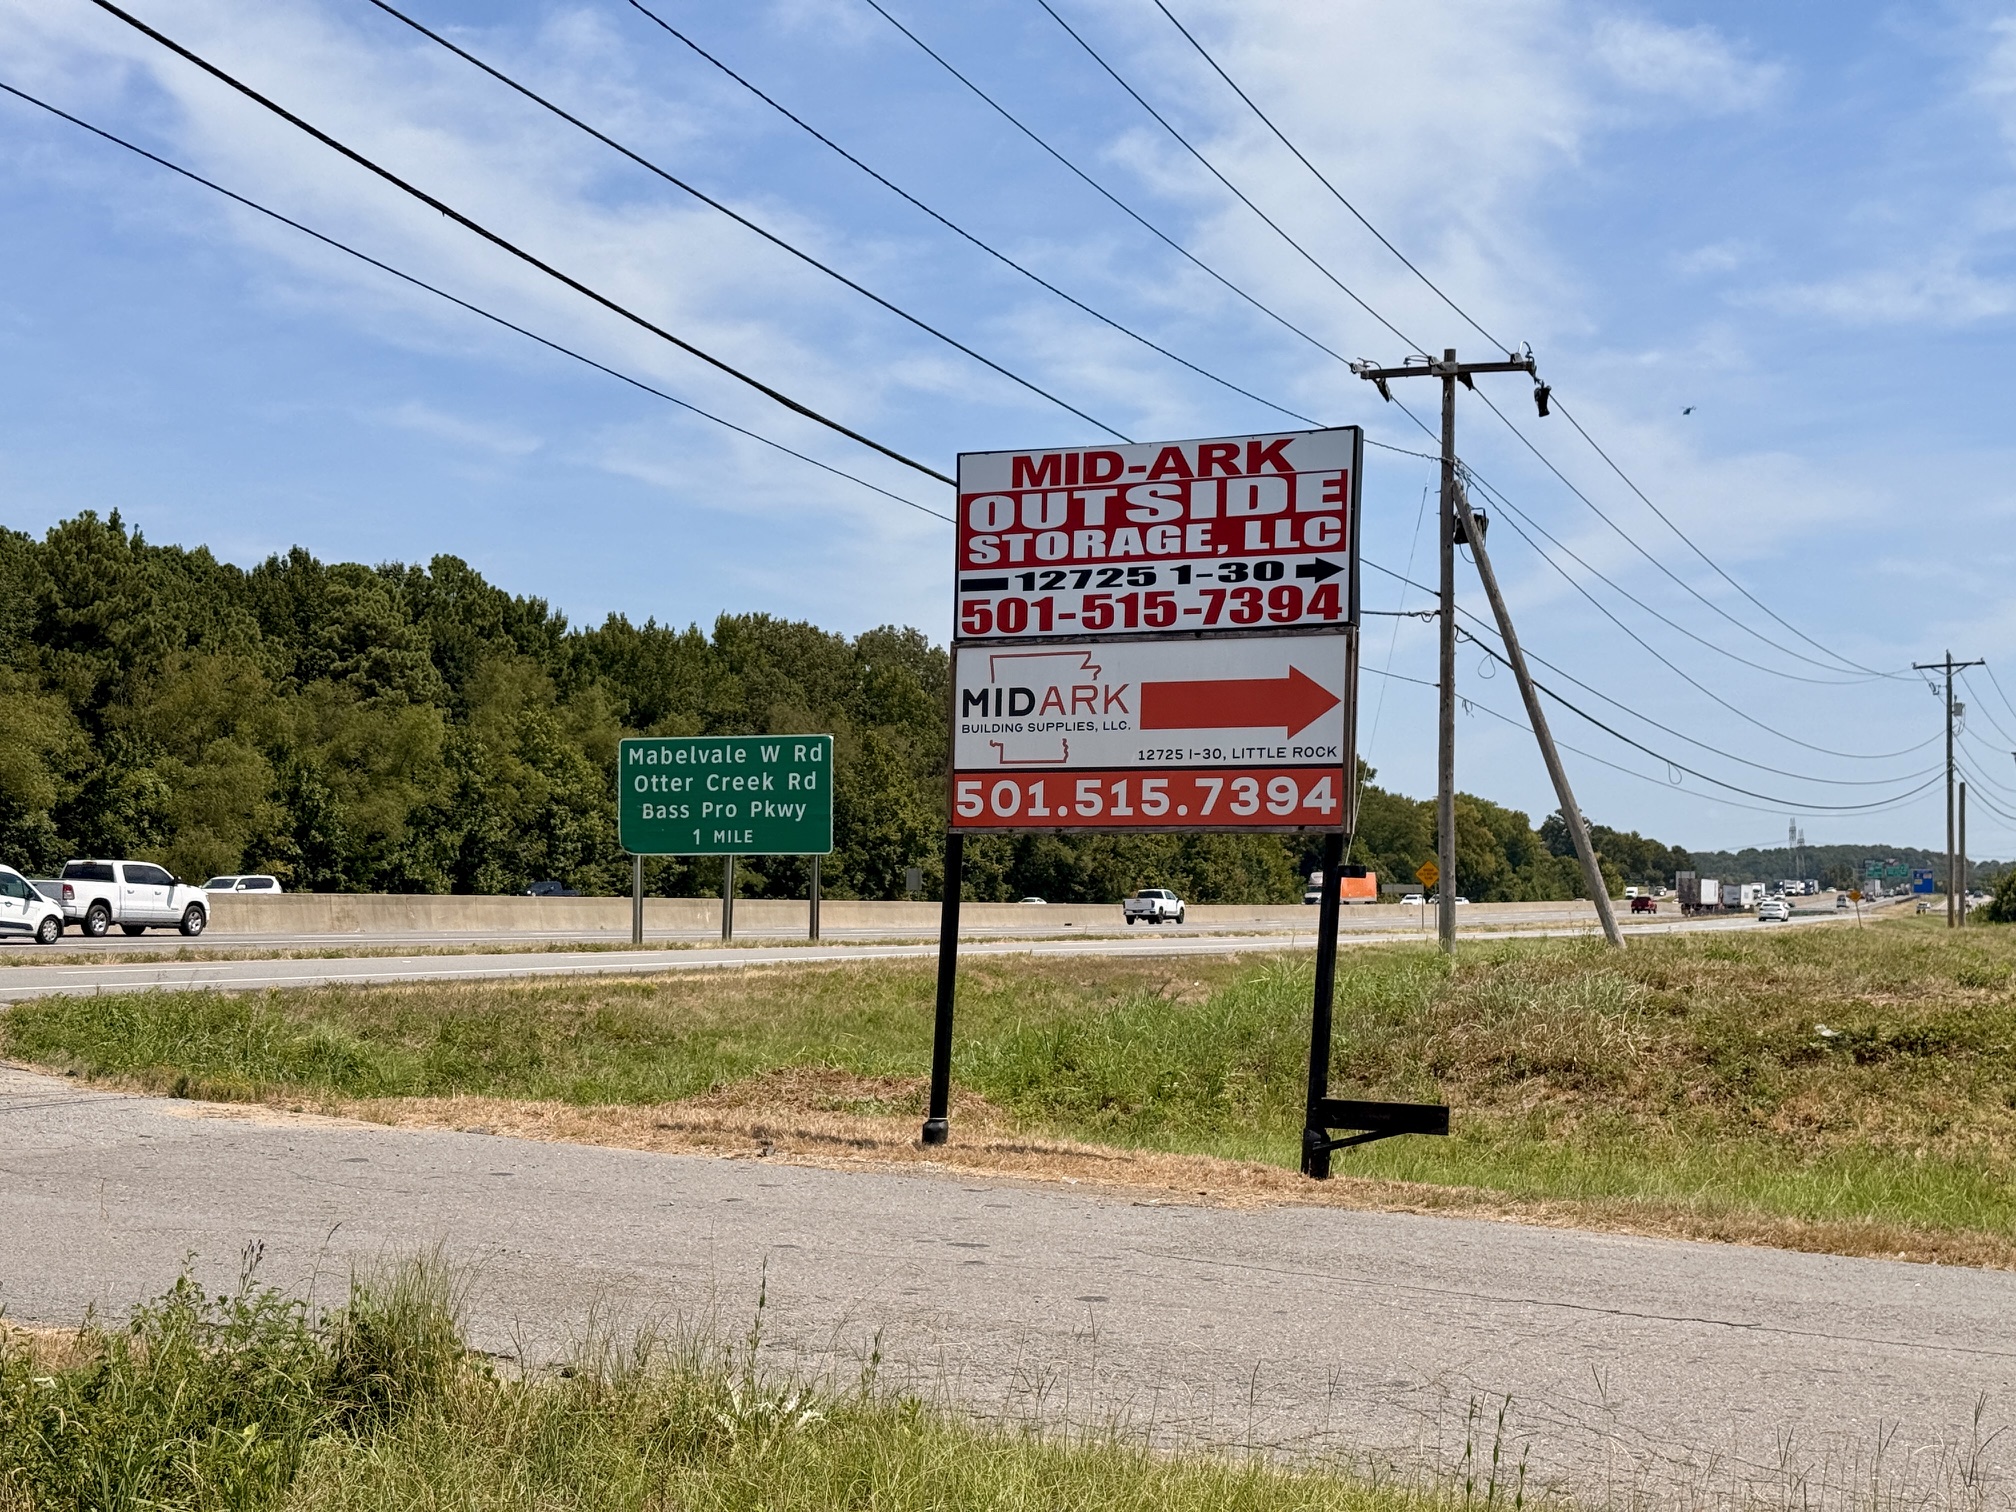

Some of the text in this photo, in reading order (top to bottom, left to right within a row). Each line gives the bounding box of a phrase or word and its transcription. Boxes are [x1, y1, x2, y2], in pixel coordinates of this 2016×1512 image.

[1012, 438, 1296, 489] MID-ARK
[969, 470, 1343, 532] OUTSIDE
[968, 516, 1342, 564] STORAGE, LLC
[1015, 566, 1157, 592] 12725
[961, 583, 1343, 635] 501-515-7394
[962, 683, 1131, 718] MIDARK
[961, 721, 1132, 734] BUILDING SUPPLIES, LLC.
[629, 743, 822, 765] Mabelvale W Rd
[1138, 745, 1338, 762] 12725 I-30, LITTLE ROCK
[634, 771, 816, 793] Otter Creek Rd
[956, 776, 1337, 818] 501.515.7394
[642, 800, 807, 822] Bass Pro Pkwy
[692, 829, 753, 845] 1 MILE
